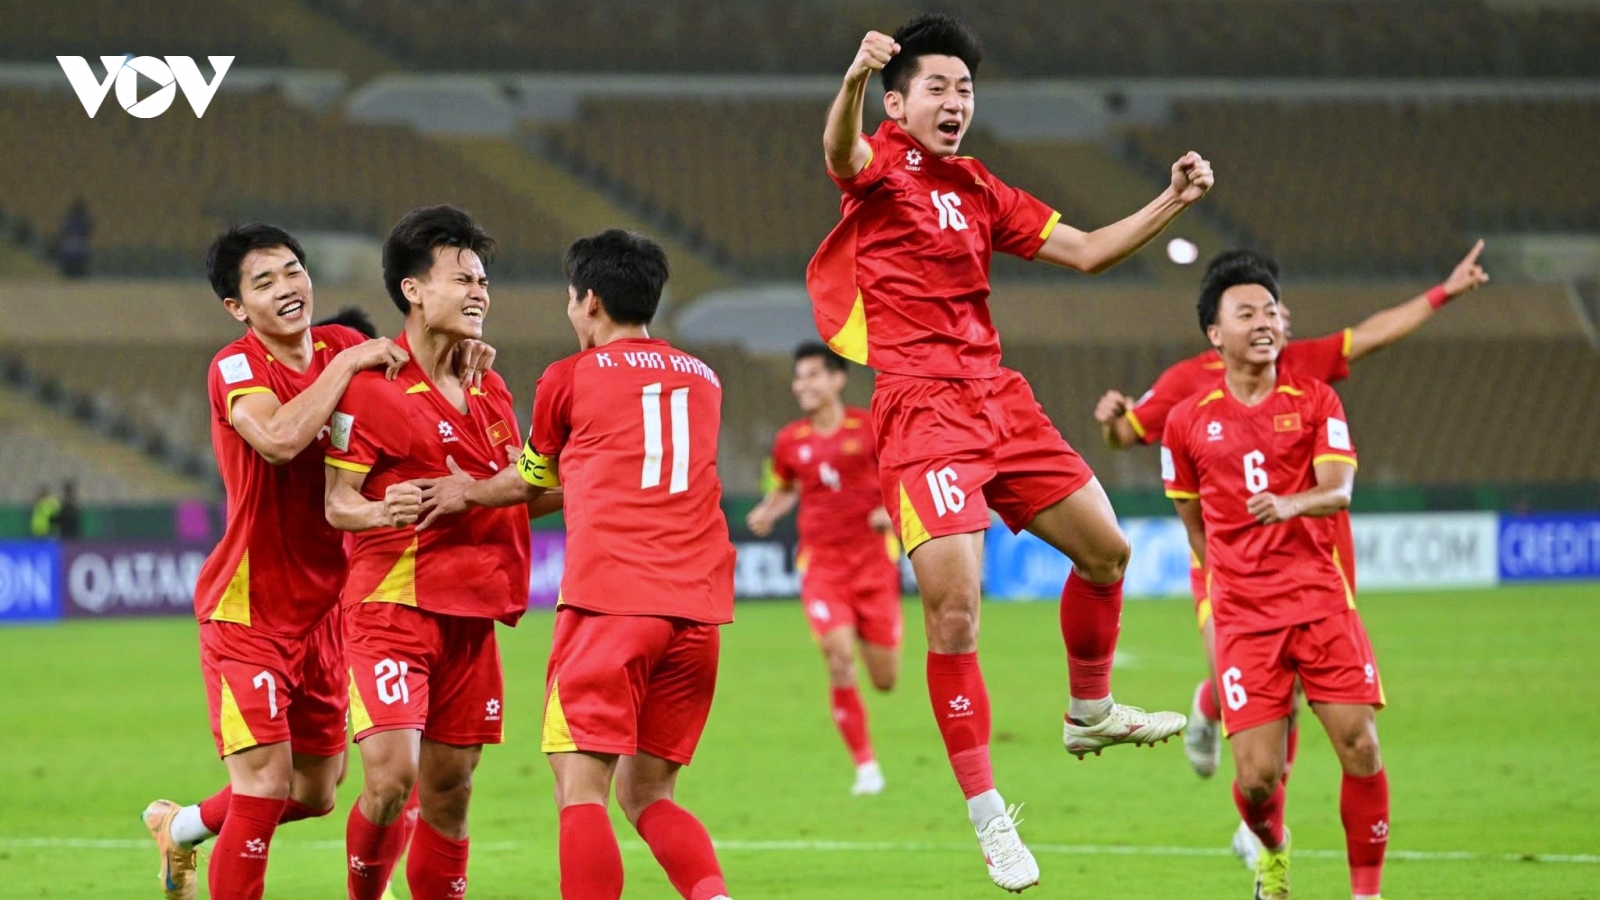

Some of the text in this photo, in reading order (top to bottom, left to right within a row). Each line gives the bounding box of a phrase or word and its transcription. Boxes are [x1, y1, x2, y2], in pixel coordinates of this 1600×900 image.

[930, 189, 970, 232] 16
[624, 351, 666, 370] VAN
[641, 381, 690, 495] 11
[925, 465, 967, 518] 16
[1243, 449, 1269, 495] 6
[252, 670, 278, 720] 7
[374, 657, 410, 706] 21
[1221, 665, 1248, 712] 6
